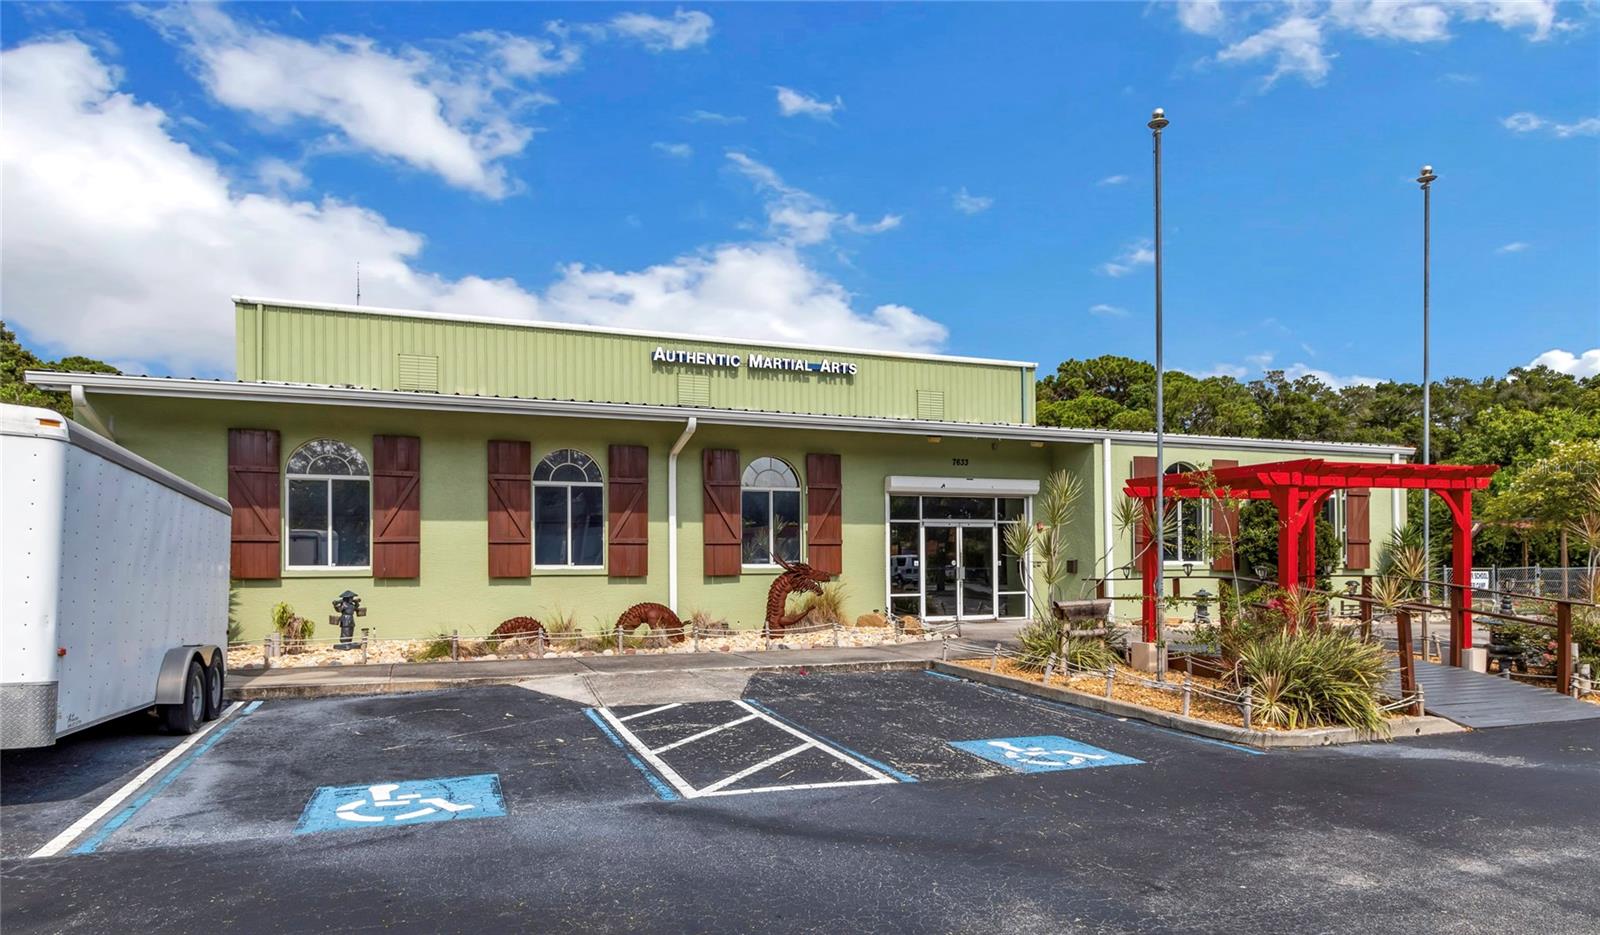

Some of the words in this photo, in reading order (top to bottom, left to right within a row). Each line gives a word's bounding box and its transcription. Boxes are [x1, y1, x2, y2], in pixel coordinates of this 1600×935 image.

[653, 346, 741, 367] AUTHENTIC
[749, 353, 813, 373] MARTIAL
[819, 359, 858, 375] ARTS
[952, 458, 969, 466] 7633
